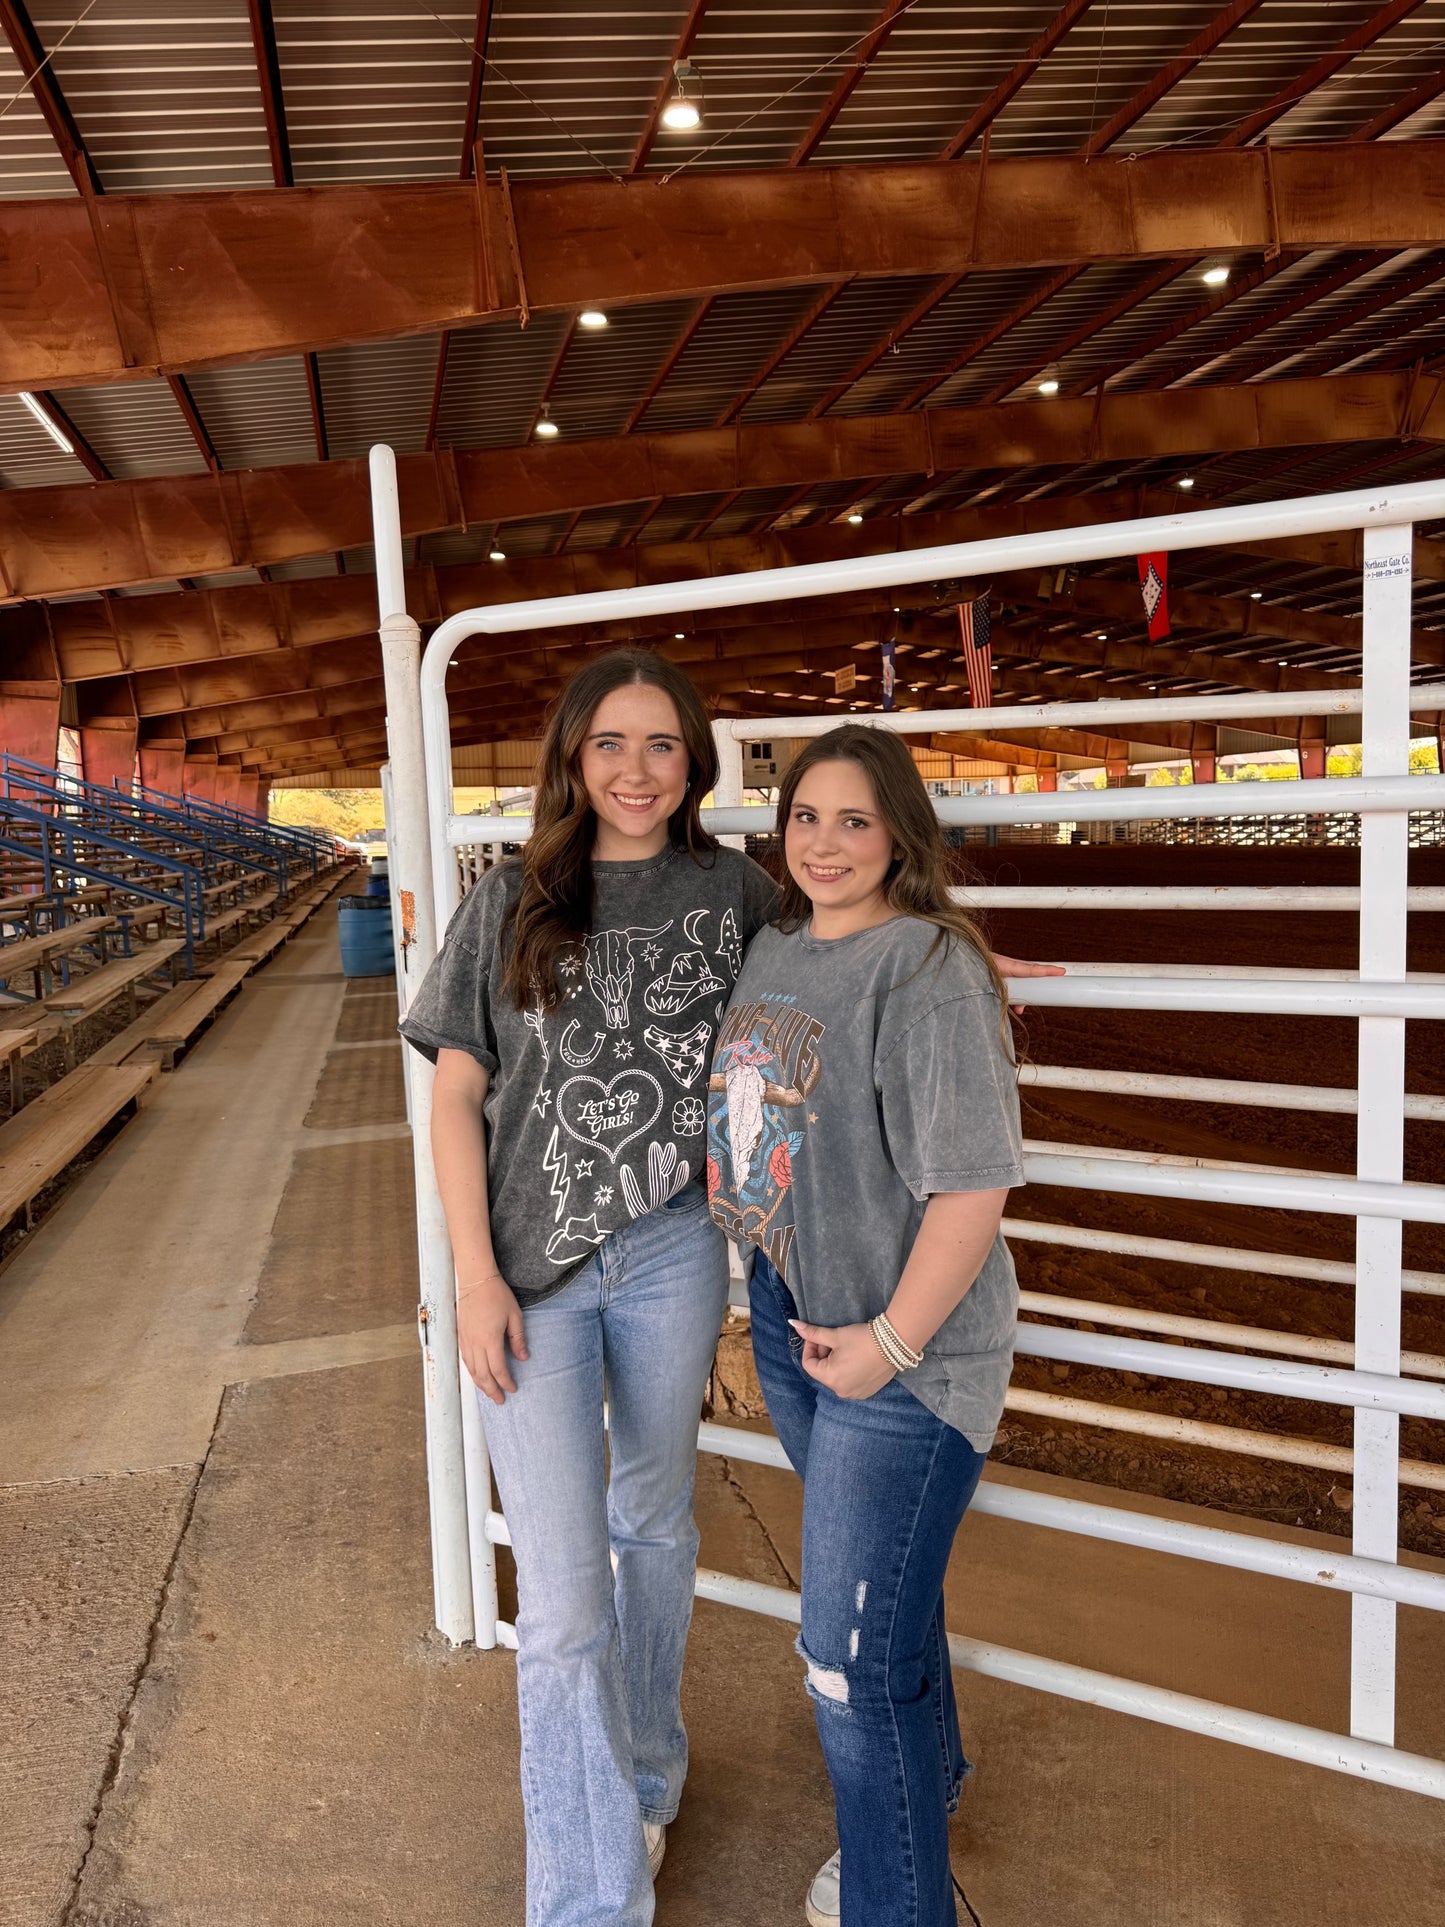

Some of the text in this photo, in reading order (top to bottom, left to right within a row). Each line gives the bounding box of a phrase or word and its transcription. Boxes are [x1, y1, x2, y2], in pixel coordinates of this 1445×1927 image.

[1365, 559, 1388, 570] Northeast
[1389, 557, 1401, 567] Gate
[762, 1006, 826, 1103] LIVE
[577, 1099, 616, 1121] LET'S
[586, 1111, 634, 1140] GIRLS!
